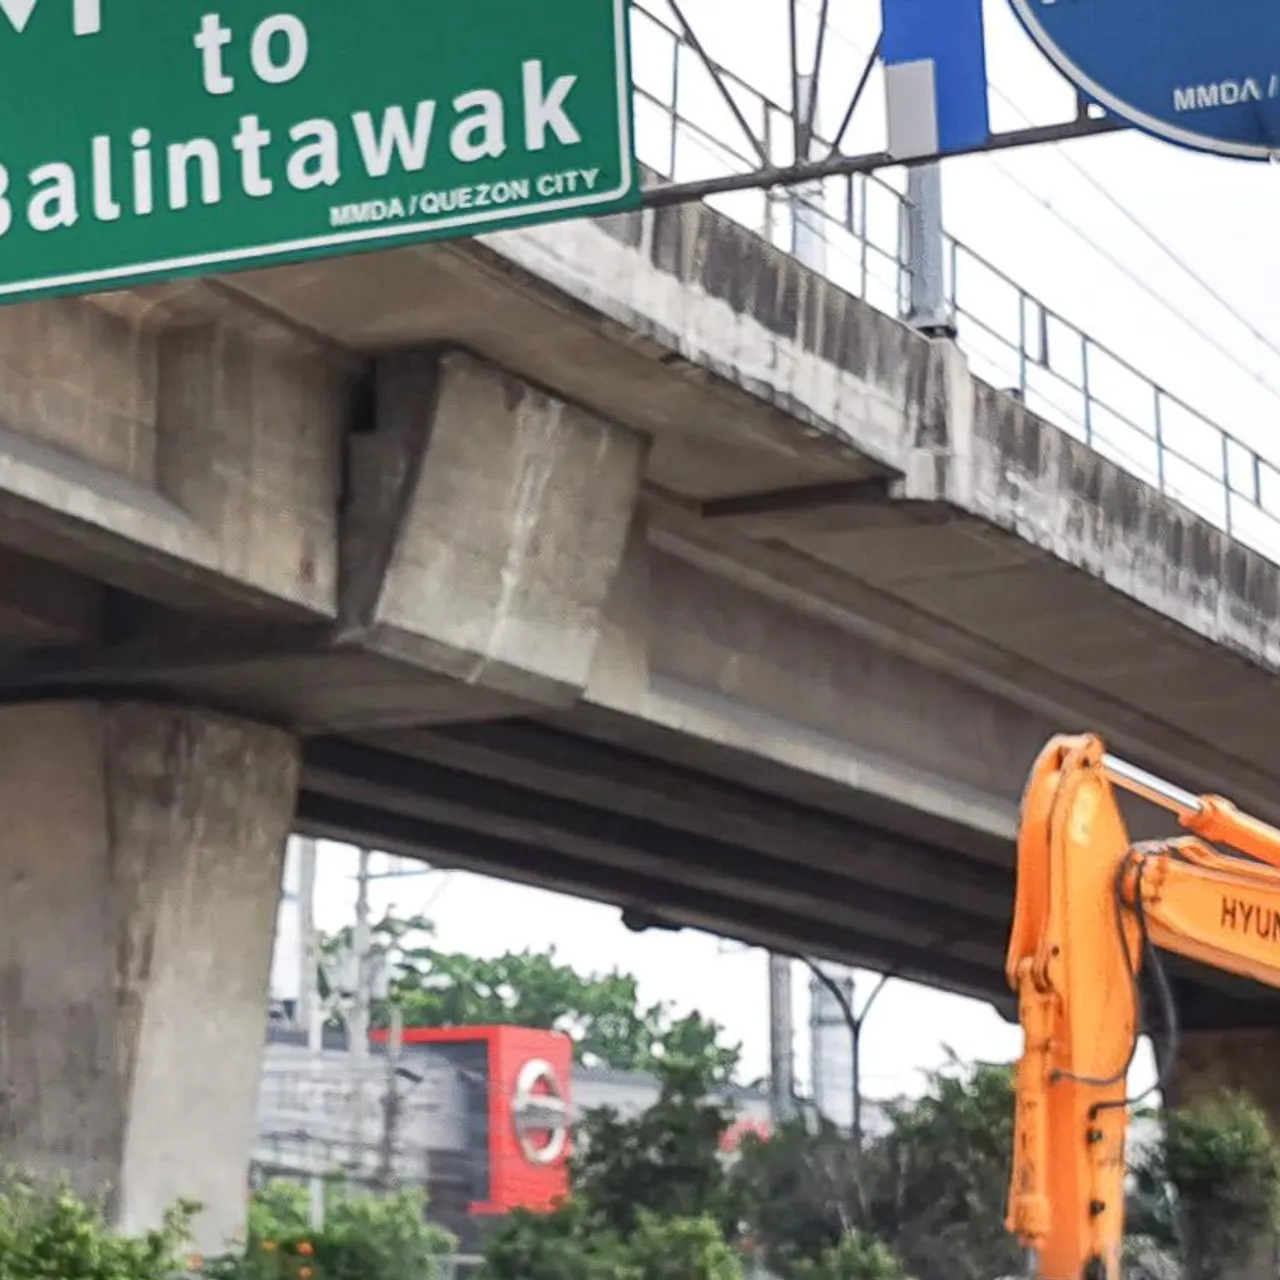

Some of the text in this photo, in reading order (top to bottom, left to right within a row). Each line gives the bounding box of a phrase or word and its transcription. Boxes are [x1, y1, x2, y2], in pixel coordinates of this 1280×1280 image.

[195, 12, 309, 95] to
[1173, 79, 1261, 112] MMDA
[329, 203, 405, 227] MMDA
[536, 168, 601, 197] CITY
